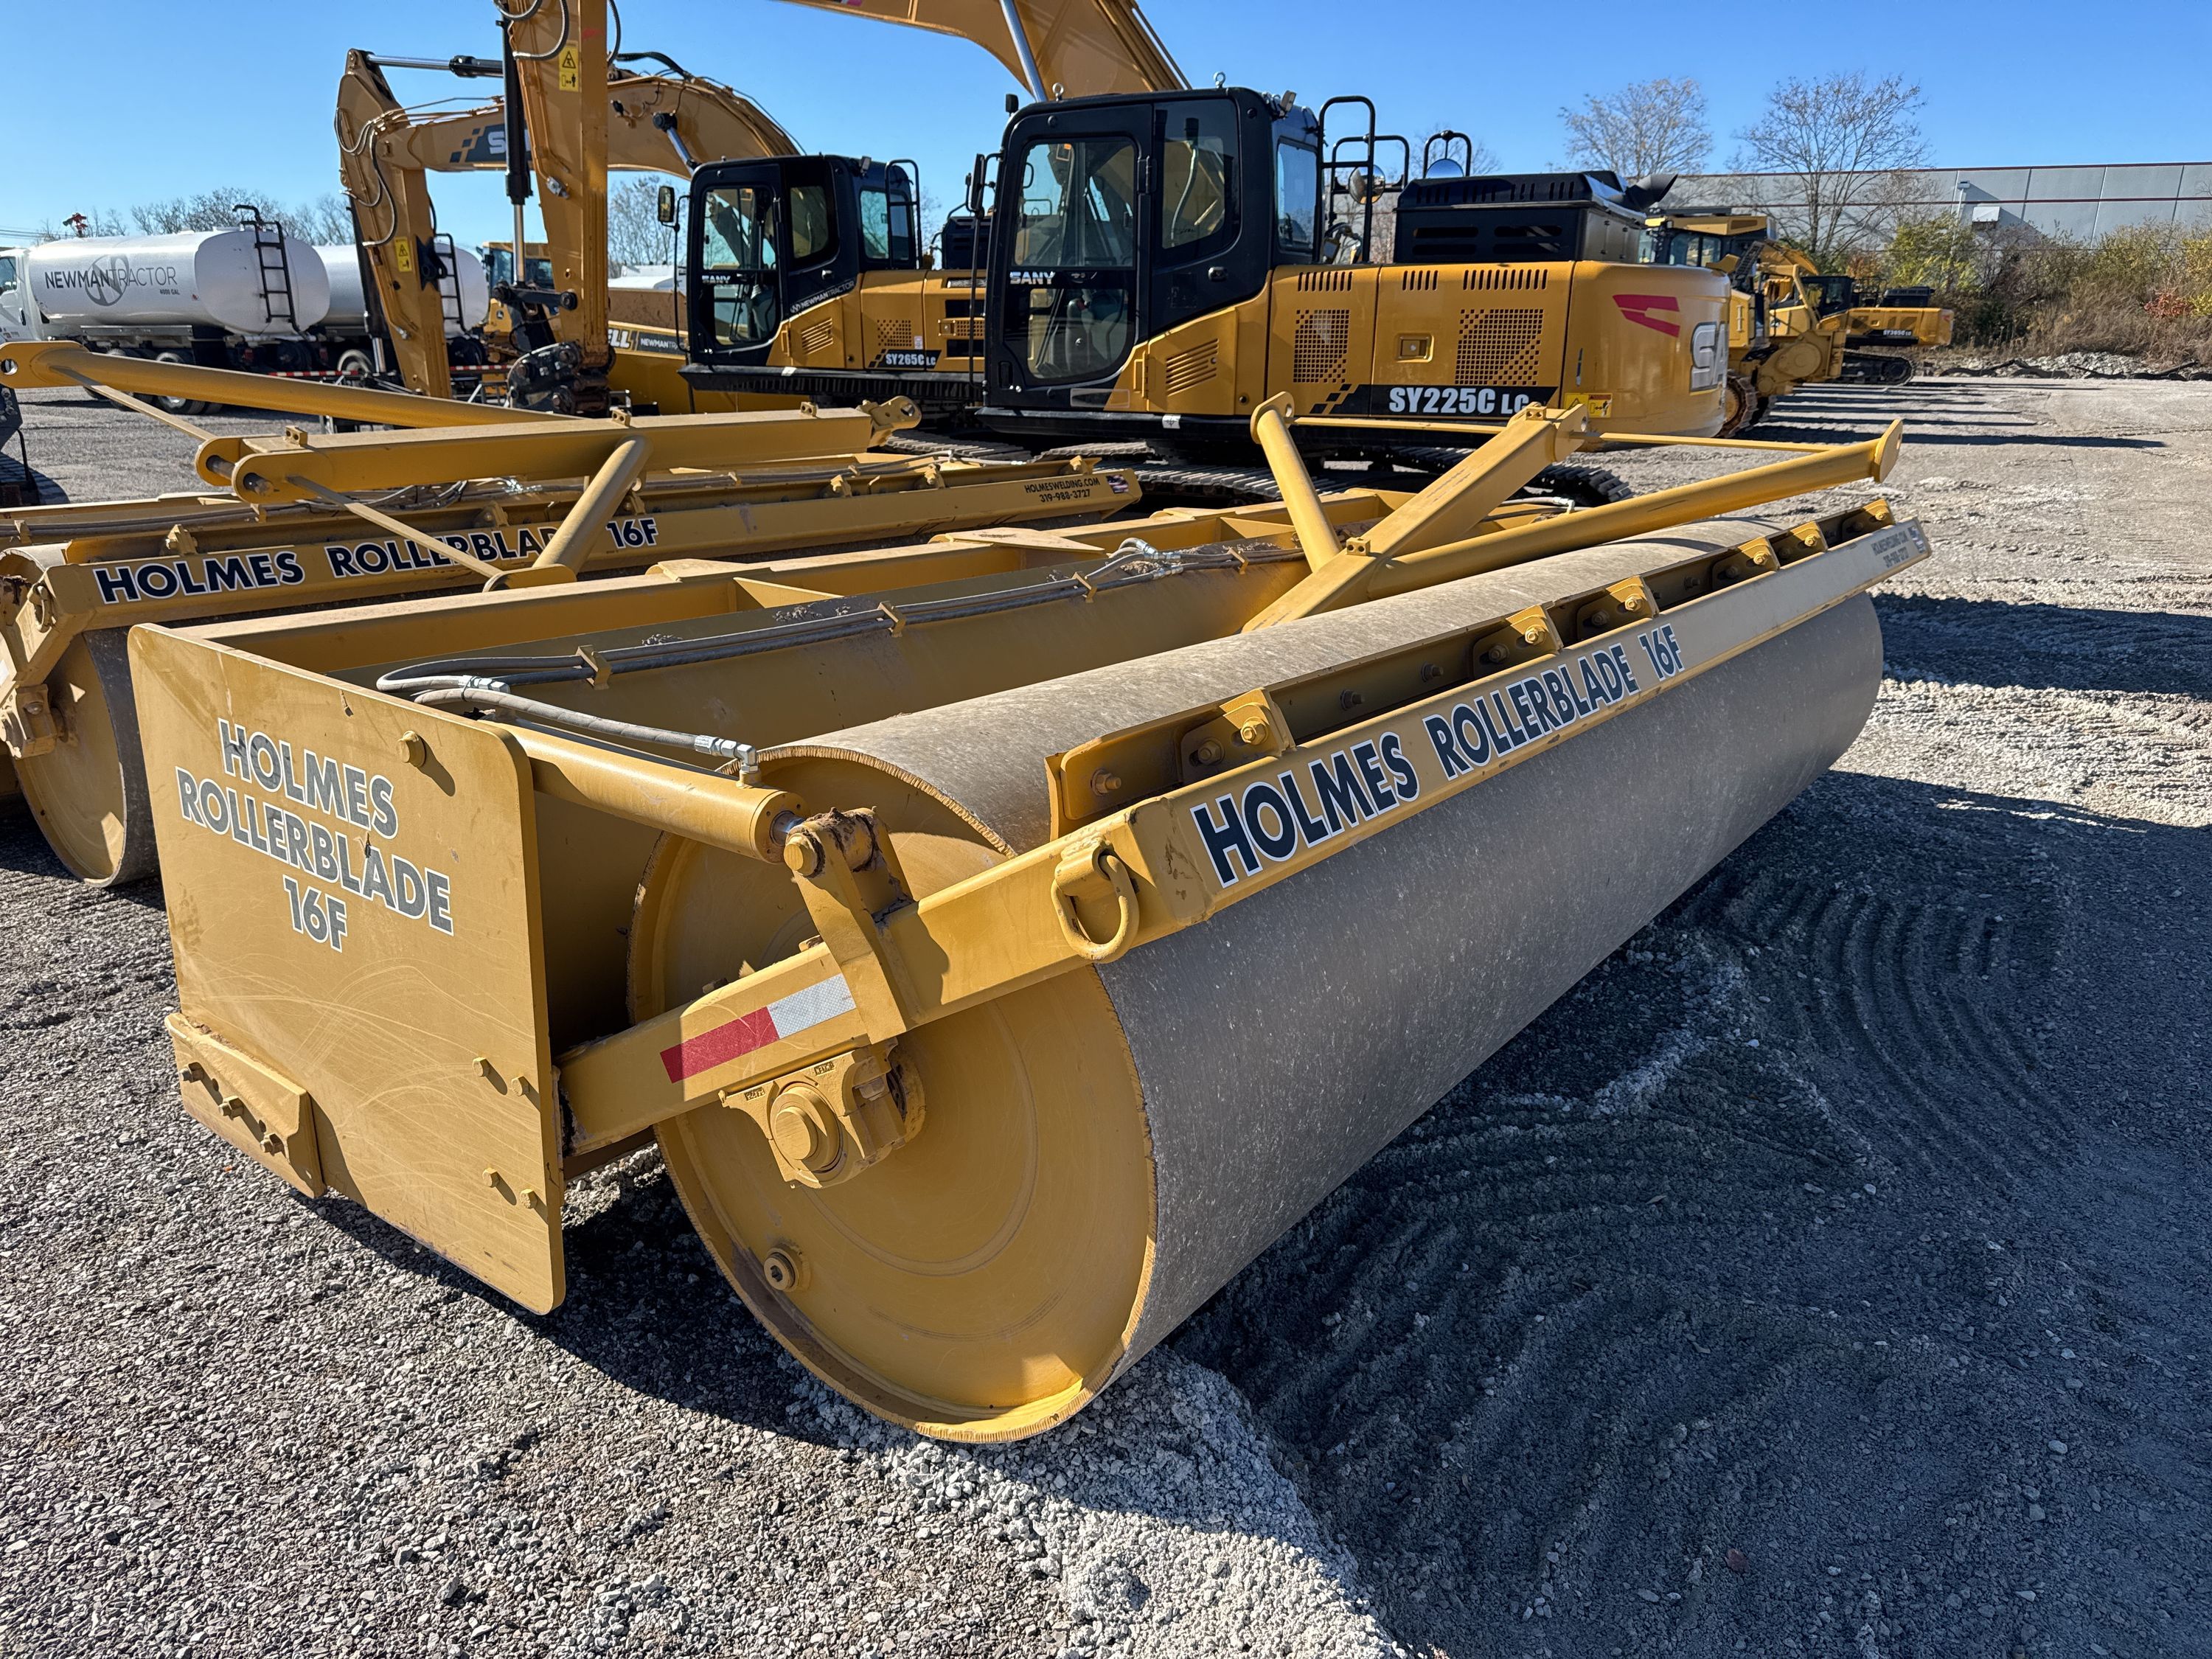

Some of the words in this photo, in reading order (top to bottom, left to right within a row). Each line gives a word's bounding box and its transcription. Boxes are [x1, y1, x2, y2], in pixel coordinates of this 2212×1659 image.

[44, 266, 178, 289] NEWMANTRACTOR
[701, 275, 731, 284] SANY
[1009, 271, 1055, 285] SANY
[801, 279, 855, 309] NEWMANTRACTOR
[886, 354, 925, 366] SY265C
[925, 356, 936, 366] LC
[1388, 386, 1496, 414] SY225C
[1500, 394, 1530, 414] LC
[1024, 477, 1101, 493] HOLMESWELDING.COM
[1039, 489, 1091, 503] 319-988-3727
[92, 551, 305, 605] HOLMES
[324, 526, 560, 579] ROLLERBLAD
[605, 518, 659, 549] 16F
[1189, 731, 1420, 888] HOLMES
[1422, 641, 1641, 781] ROLLERBLADE
[1637, 622, 1685, 681] 16F
[218, 717, 399, 840] HOLMES
[175, 766, 454, 937] ROLLERBLADE
[282, 874, 348, 953] 16F
